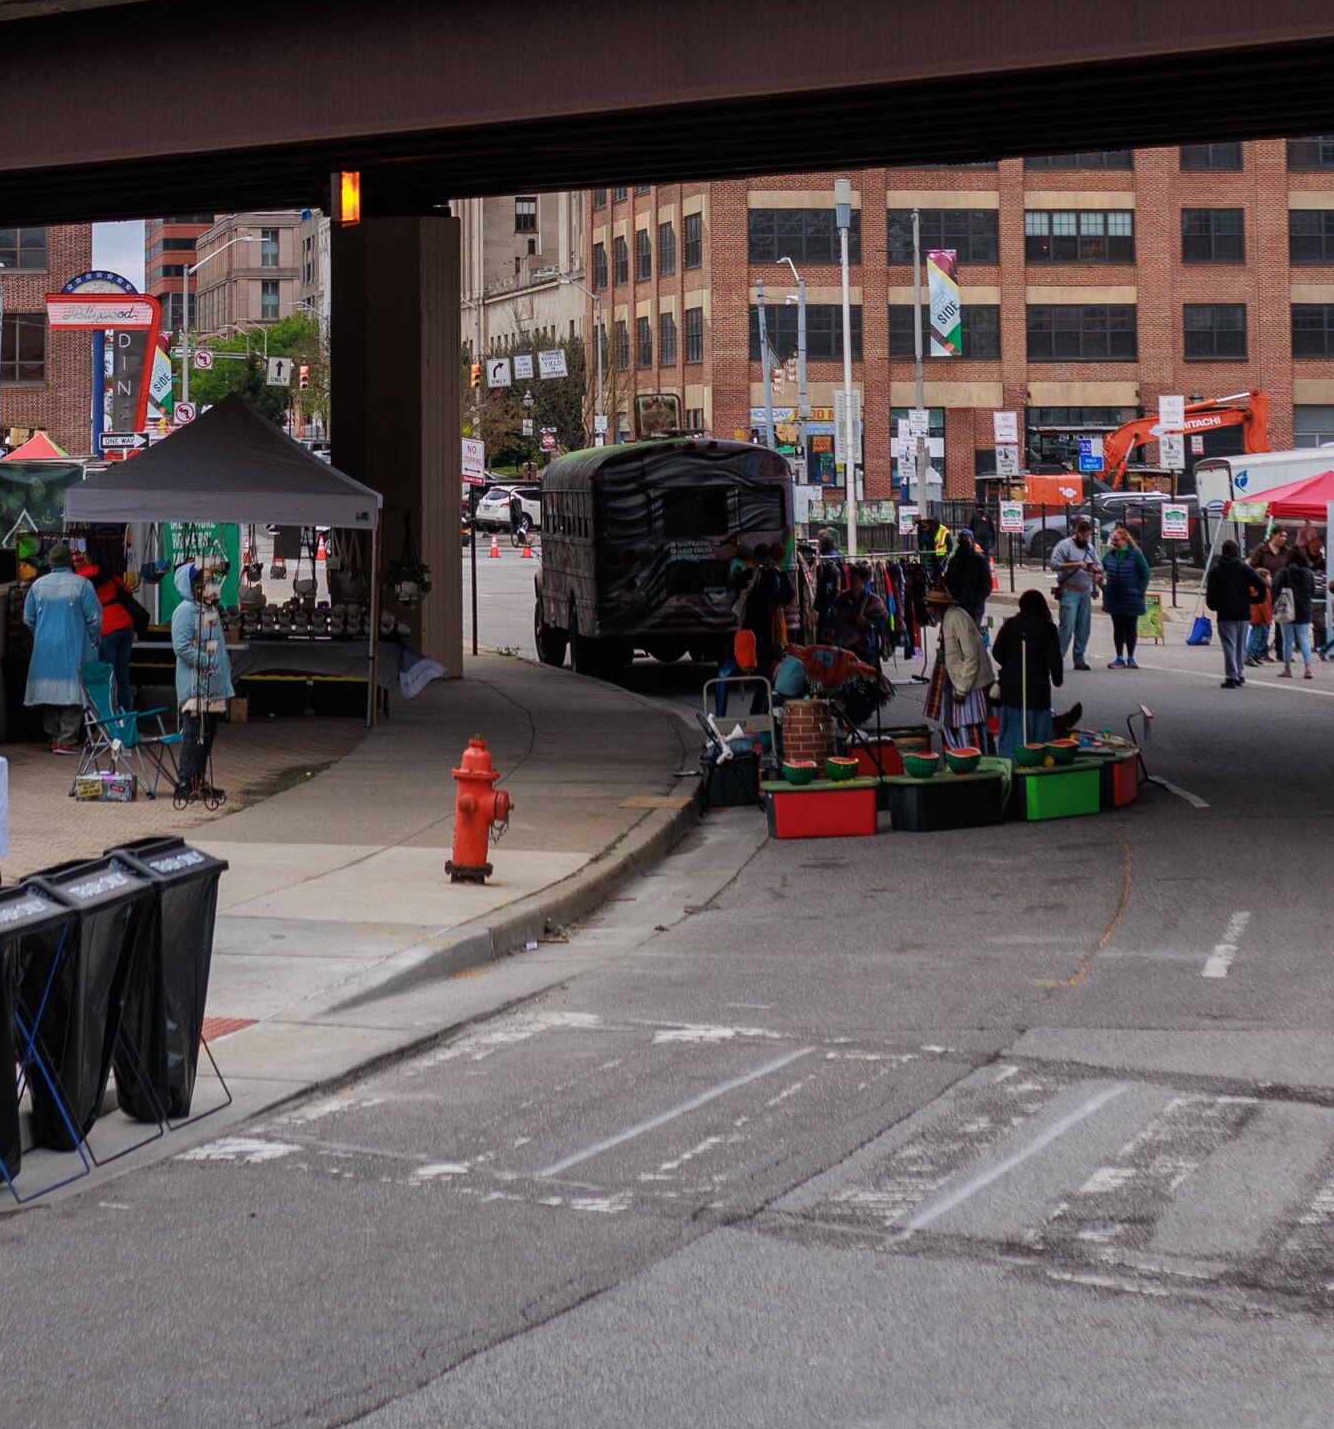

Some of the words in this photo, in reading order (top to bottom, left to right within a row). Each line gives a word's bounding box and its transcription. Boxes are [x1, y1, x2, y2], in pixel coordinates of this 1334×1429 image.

[62, 306, 138, 322] Hollywood
[937, 300, 960, 325] SIDE
[153, 372, 173, 393] SIDE
[750, 409, 790, 419] HOLDAY
[105, 436, 120, 445] ONE
[121, 436, 135, 445] WAY
[467, 445, 477, 454] NO
